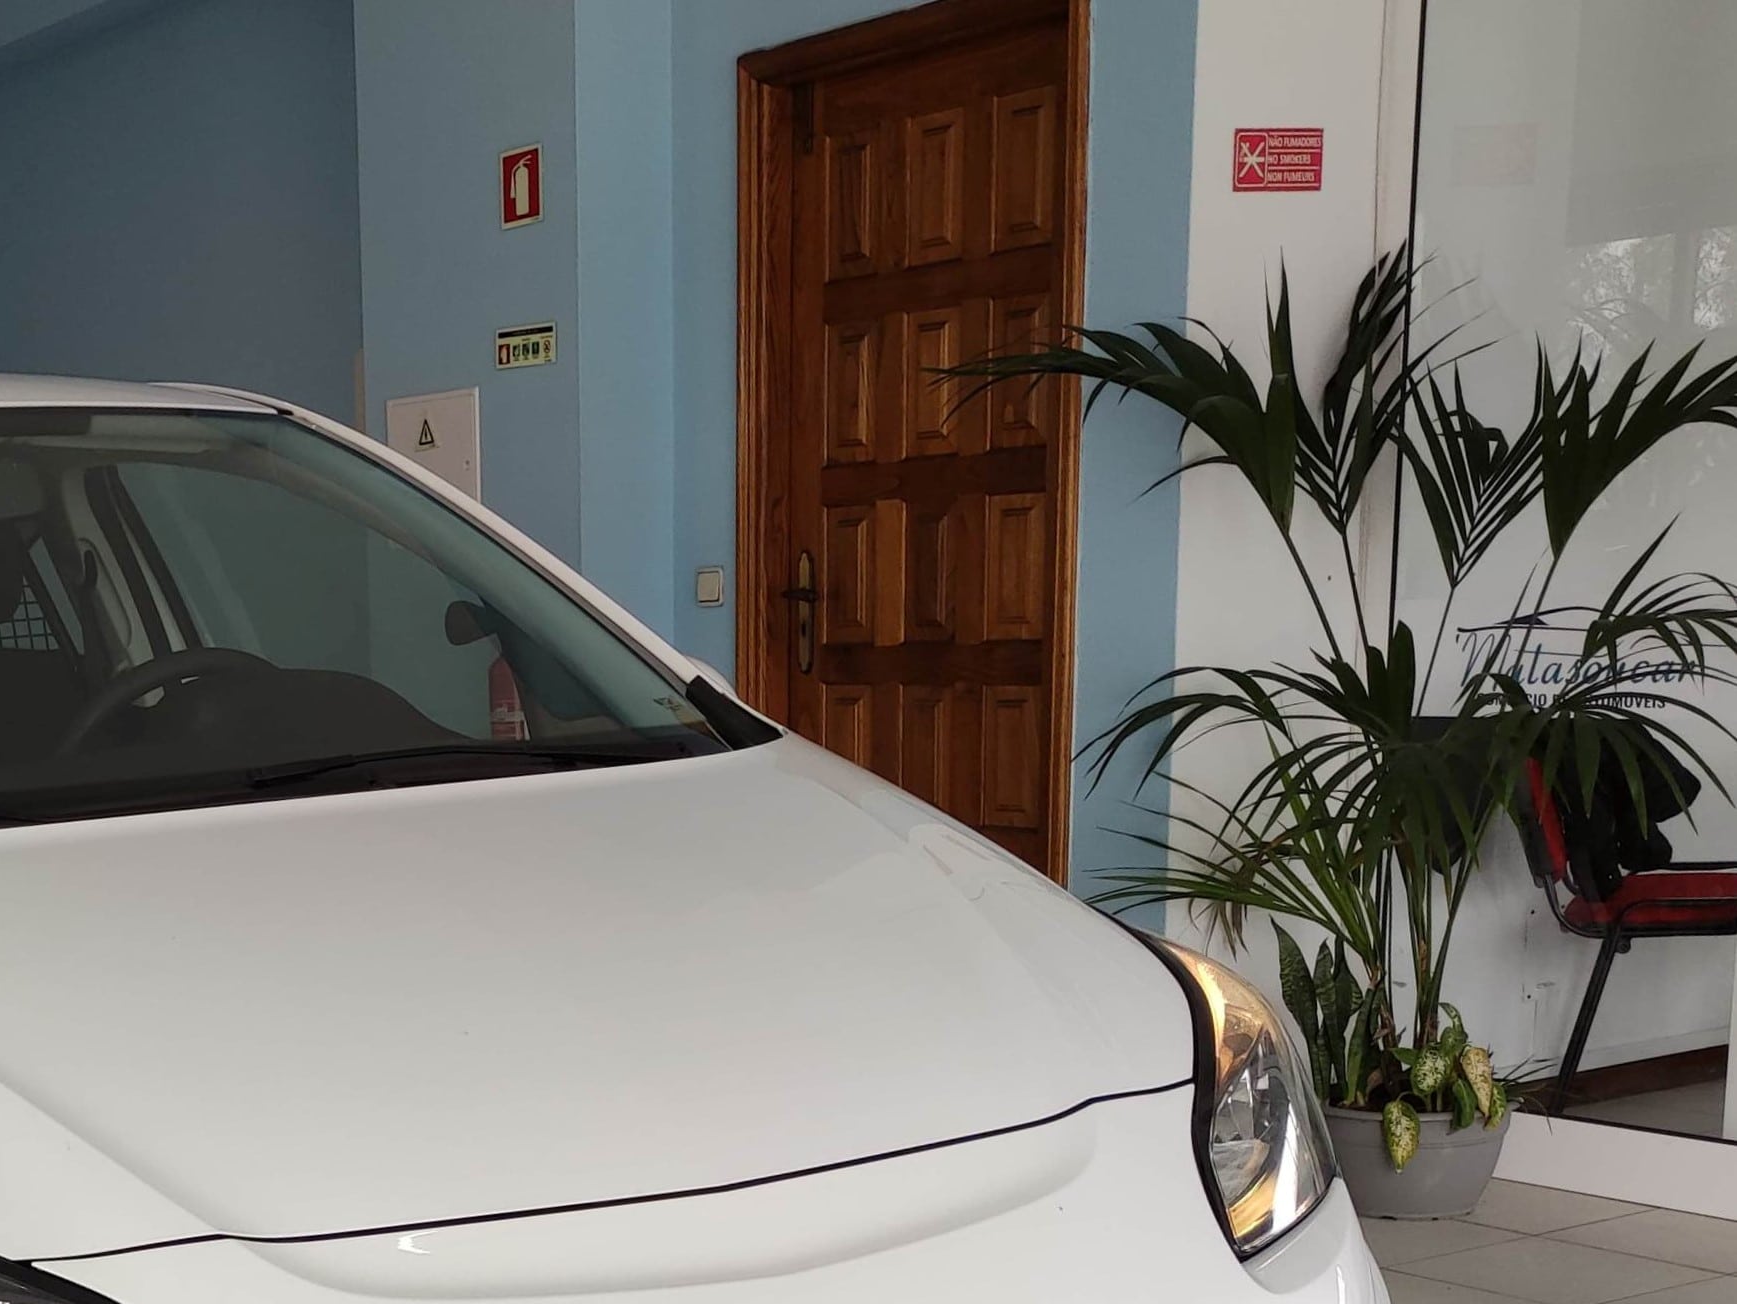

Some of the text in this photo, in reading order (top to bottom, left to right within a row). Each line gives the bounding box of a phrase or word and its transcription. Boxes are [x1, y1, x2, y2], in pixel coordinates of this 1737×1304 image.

[1268, 135, 1321, 147] NÃO FUMADORES
[1267, 154, 1311, 164] NO SMOKERS
[1267, 172, 1282, 182] NON
